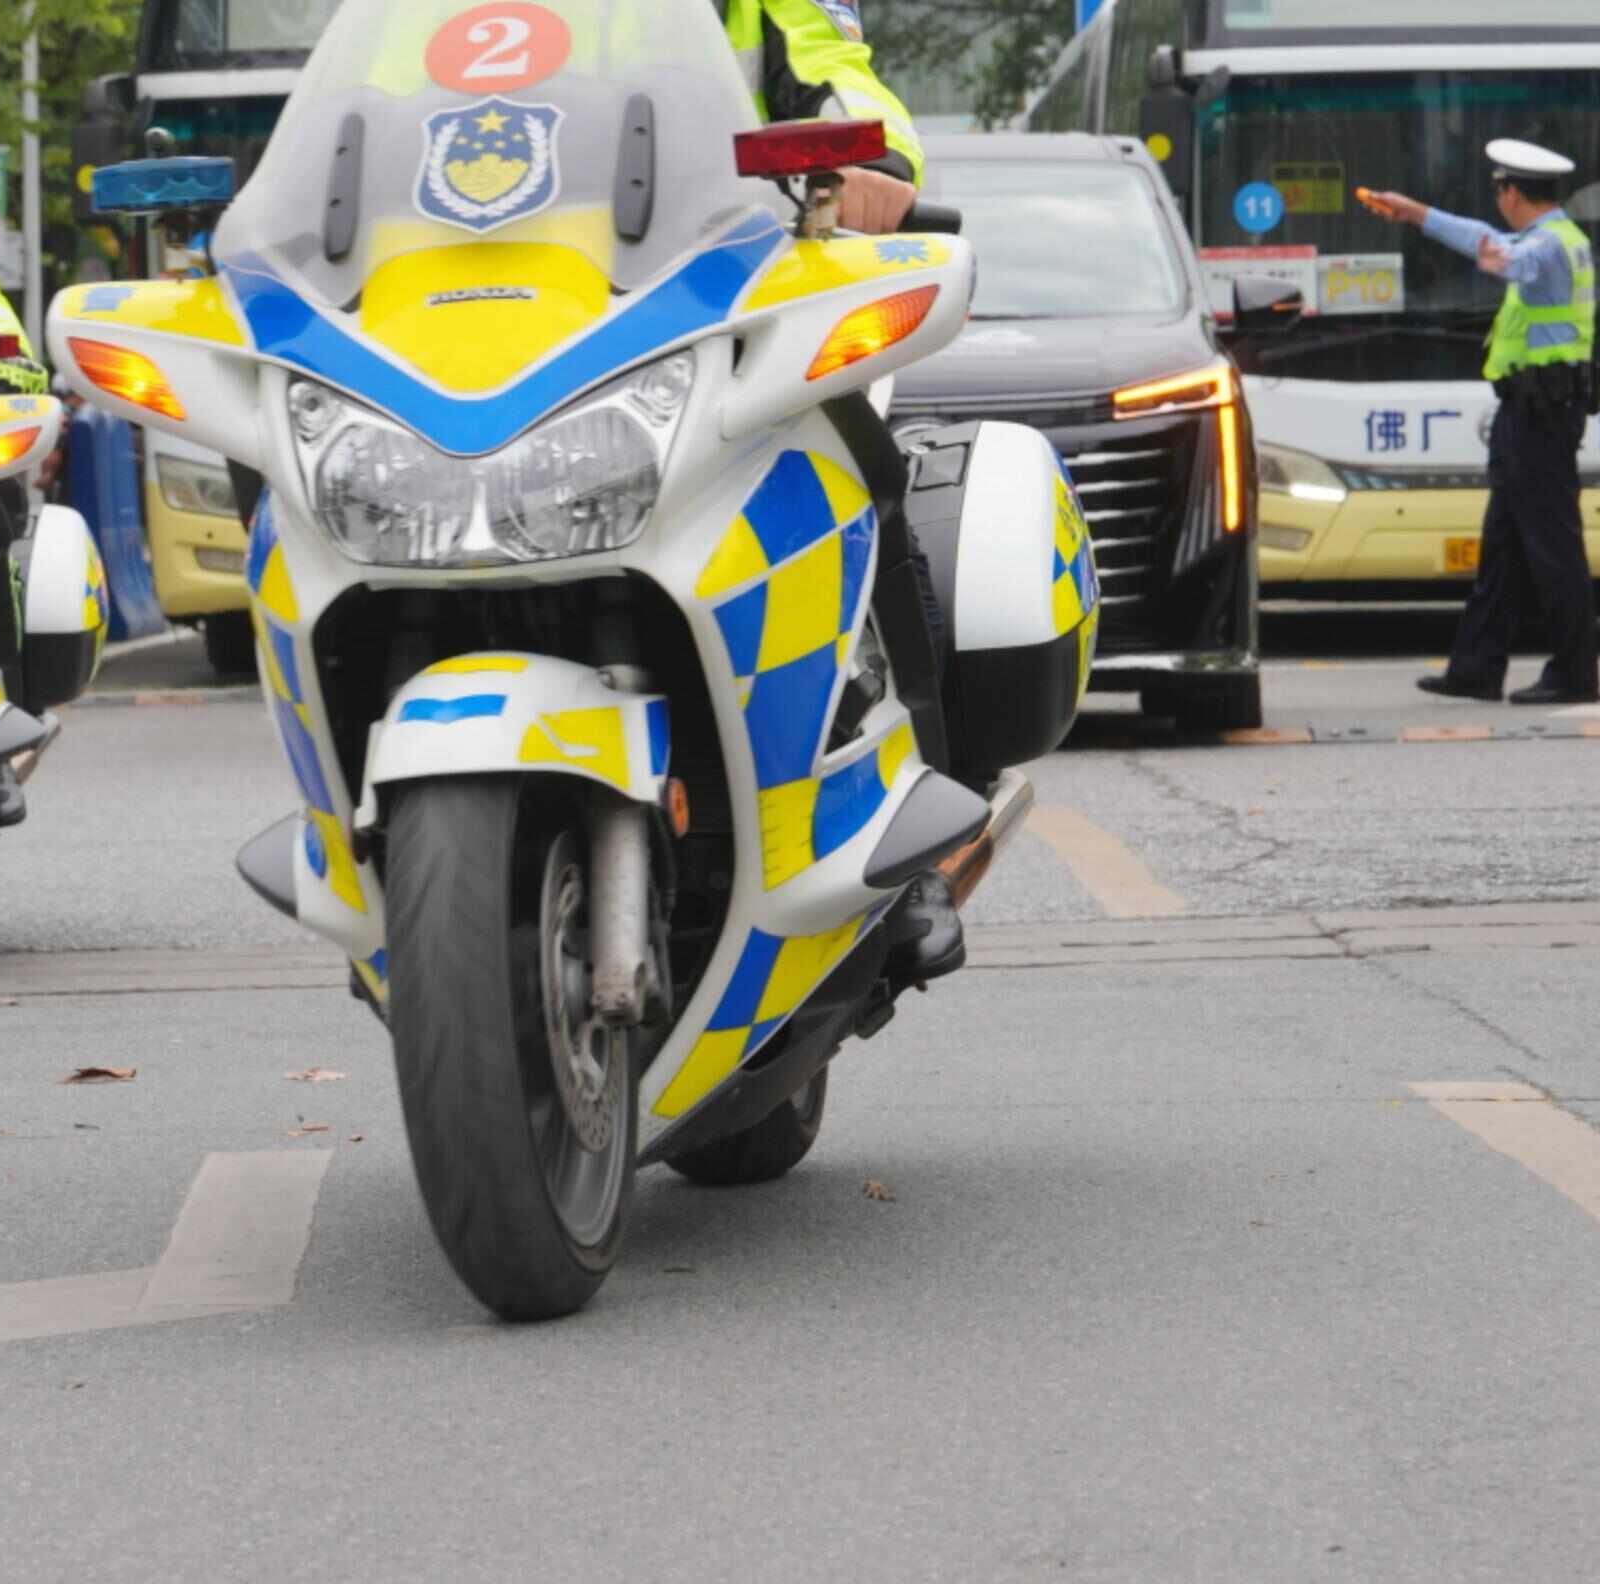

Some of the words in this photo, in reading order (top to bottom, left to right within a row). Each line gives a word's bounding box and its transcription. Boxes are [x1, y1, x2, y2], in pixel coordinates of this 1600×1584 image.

[462, 17, 531, 79] 2
[1243, 197, 1273, 219] 11
[1326, 270, 1395, 305] P10
